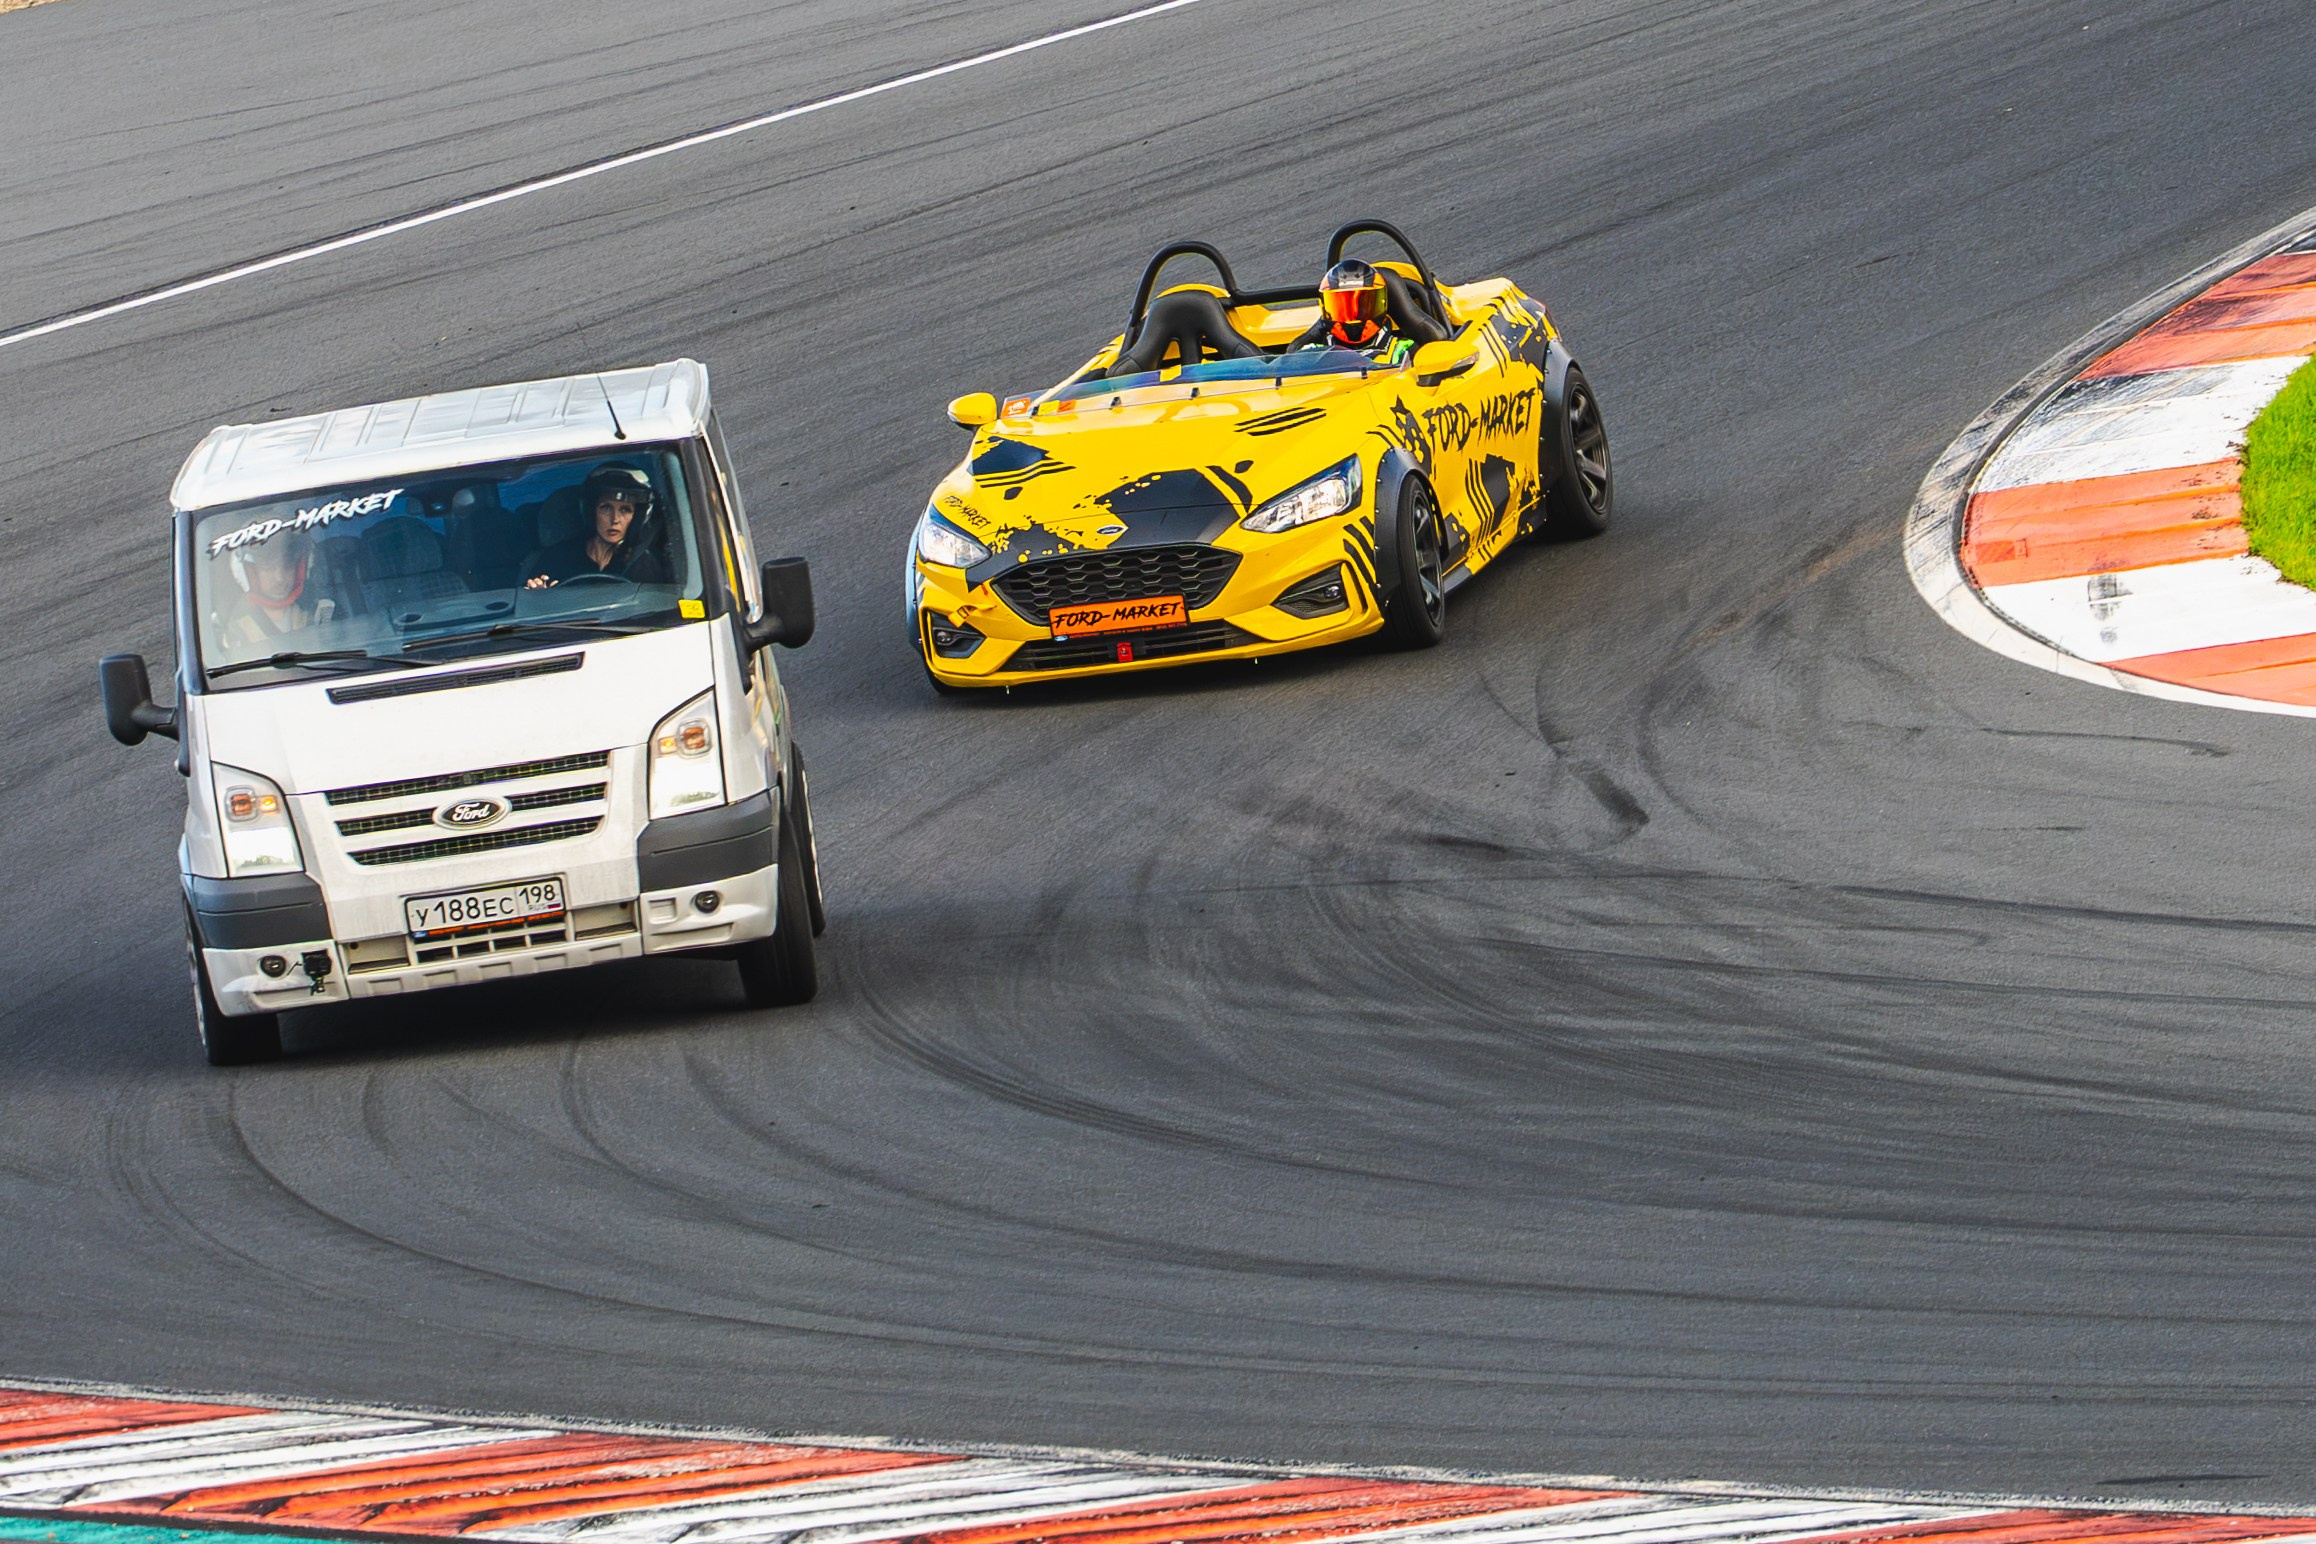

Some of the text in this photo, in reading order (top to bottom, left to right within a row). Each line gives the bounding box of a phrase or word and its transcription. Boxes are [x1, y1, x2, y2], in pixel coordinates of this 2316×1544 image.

[1421, 387, 1535, 456] FORD-MARKET
[207, 488, 405, 560] FORD-MARKET
[1052, 601, 1184, 628] FORD-MARKET
[452, 802, 490, 821] Ford
[518, 884, 556, 904] 198
